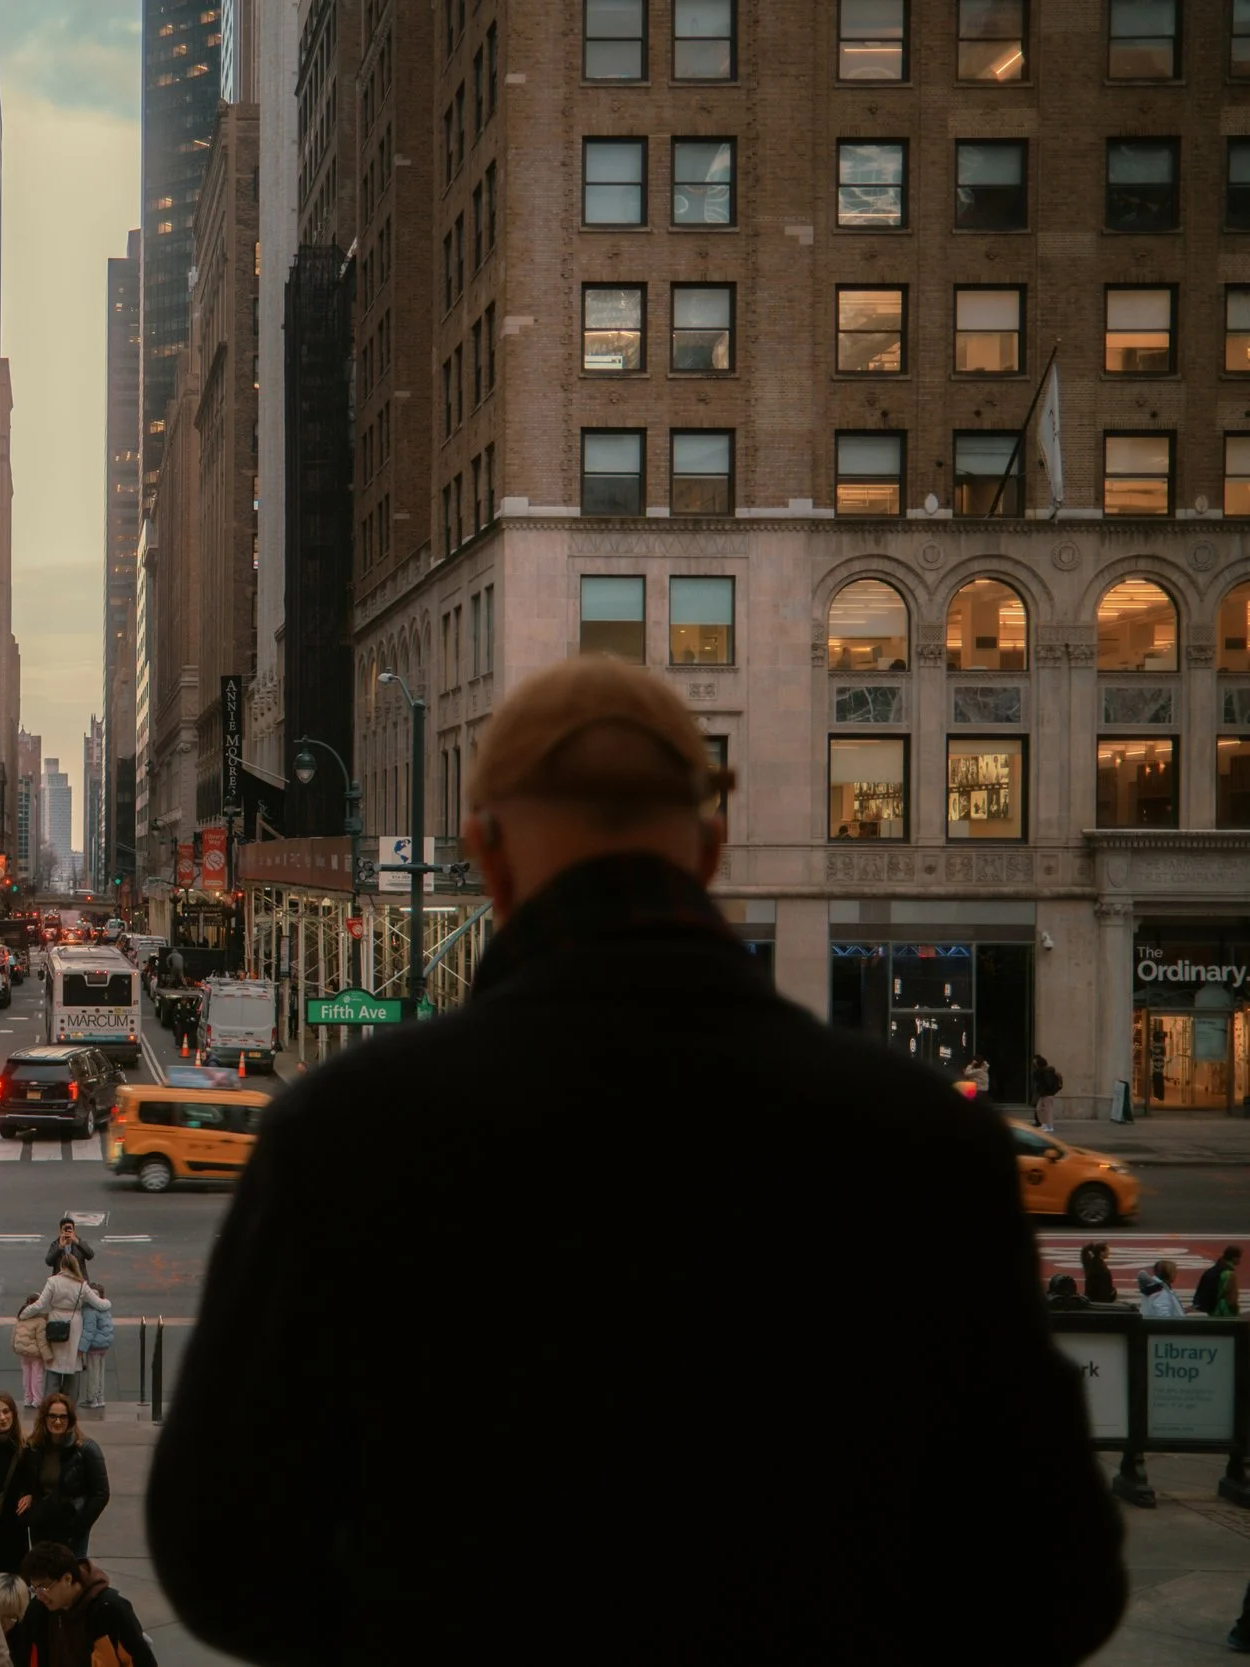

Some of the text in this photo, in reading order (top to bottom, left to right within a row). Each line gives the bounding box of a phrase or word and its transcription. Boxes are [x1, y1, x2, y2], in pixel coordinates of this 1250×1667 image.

[225, 679, 238, 731] ANNIE
[1136, 946, 1163, 959] The
[67, 1015, 128, 1028] MARCUM
[321, 1005, 387, 1020] Fifth Ave
[1154, 1343, 1219, 1365] Library
[1154, 1362, 1200, 1383] Shop
